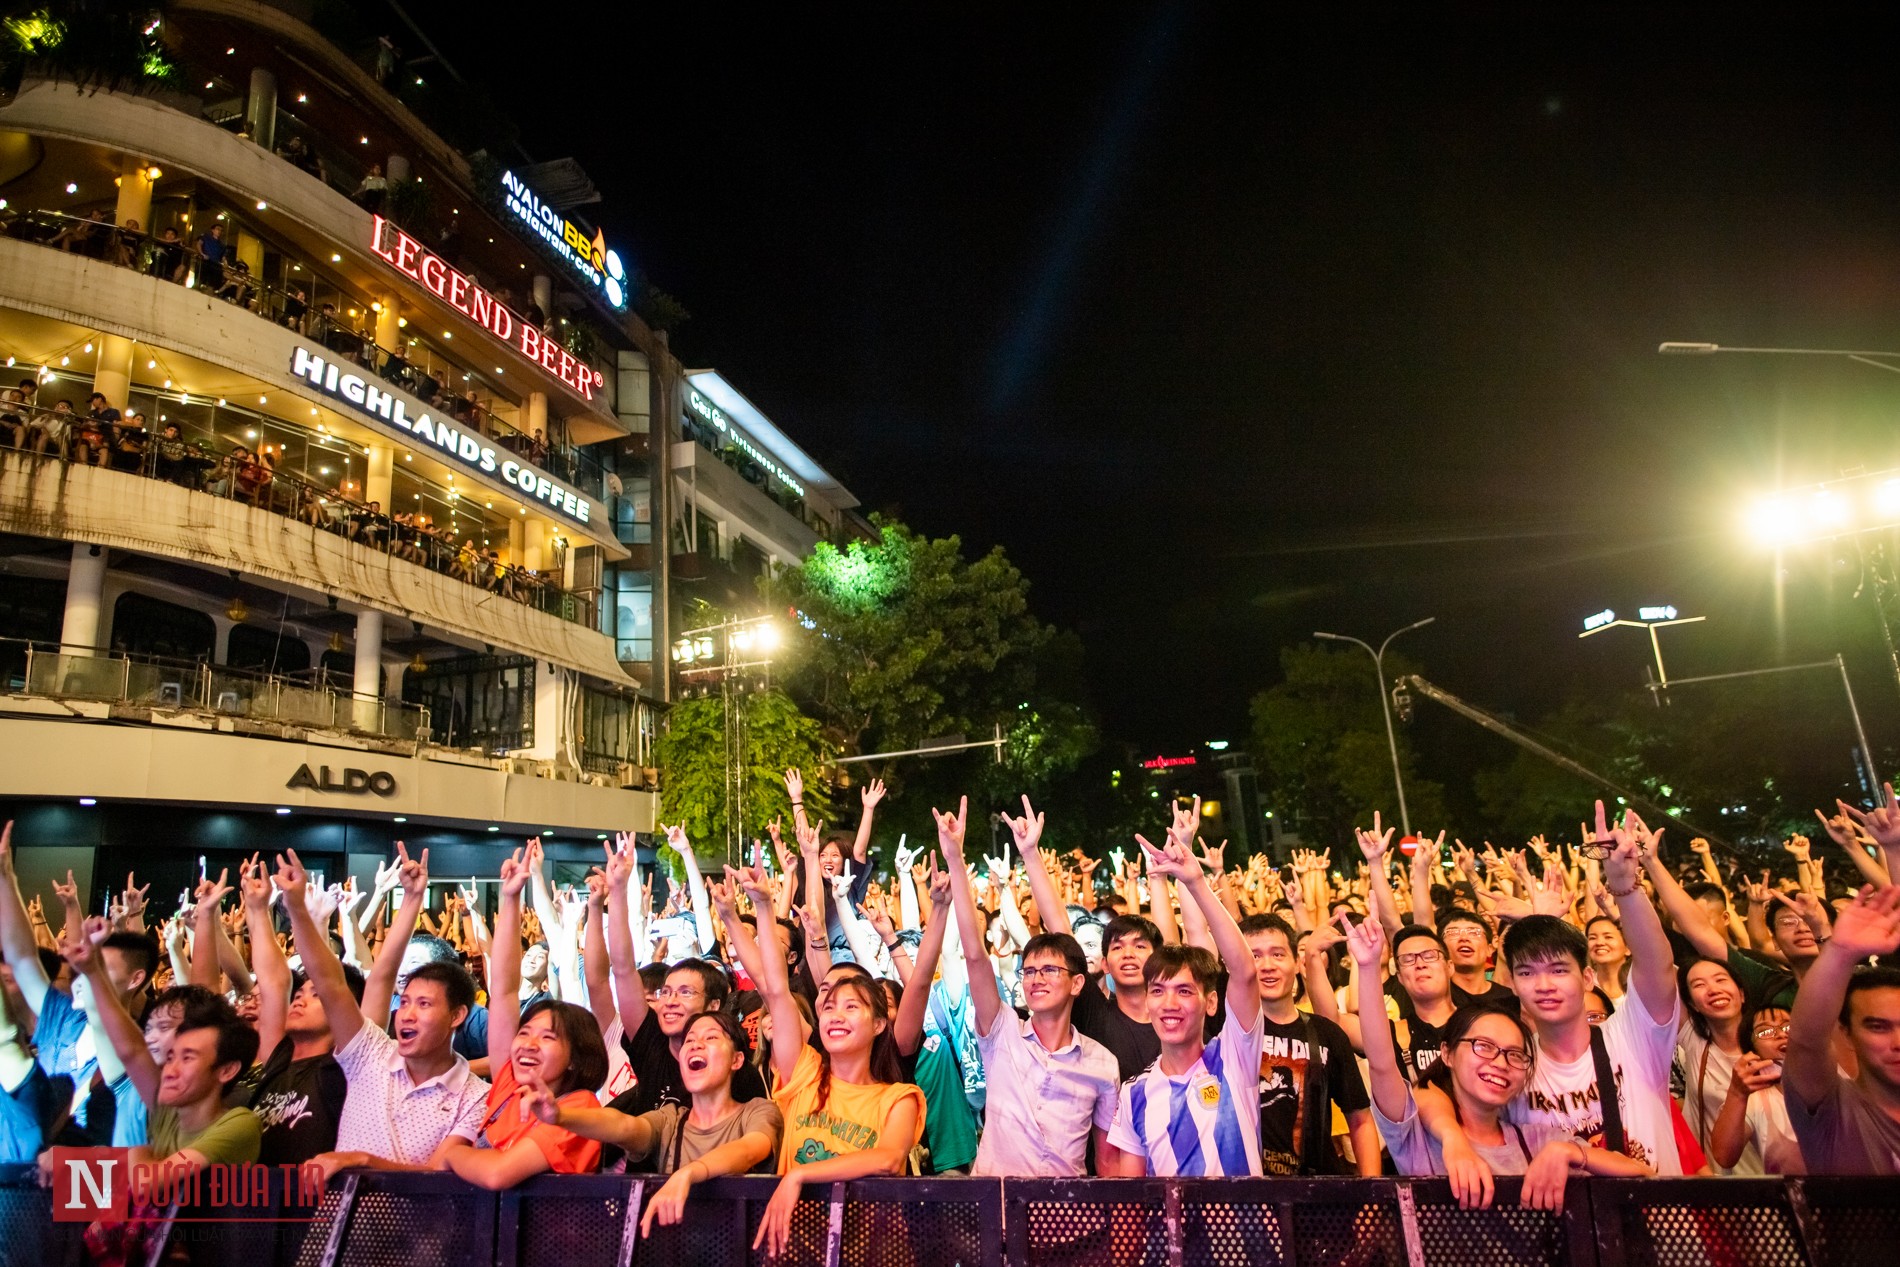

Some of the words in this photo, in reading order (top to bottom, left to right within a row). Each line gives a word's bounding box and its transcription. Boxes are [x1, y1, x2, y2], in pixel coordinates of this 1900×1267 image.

[502, 170, 563, 237] AVALON
[370, 214, 513, 341] LEGEND
[291, 346, 496, 473] HIGHLANDS
[501, 460, 590, 523] COFFEE
[285, 763, 396, 797] ALDO
